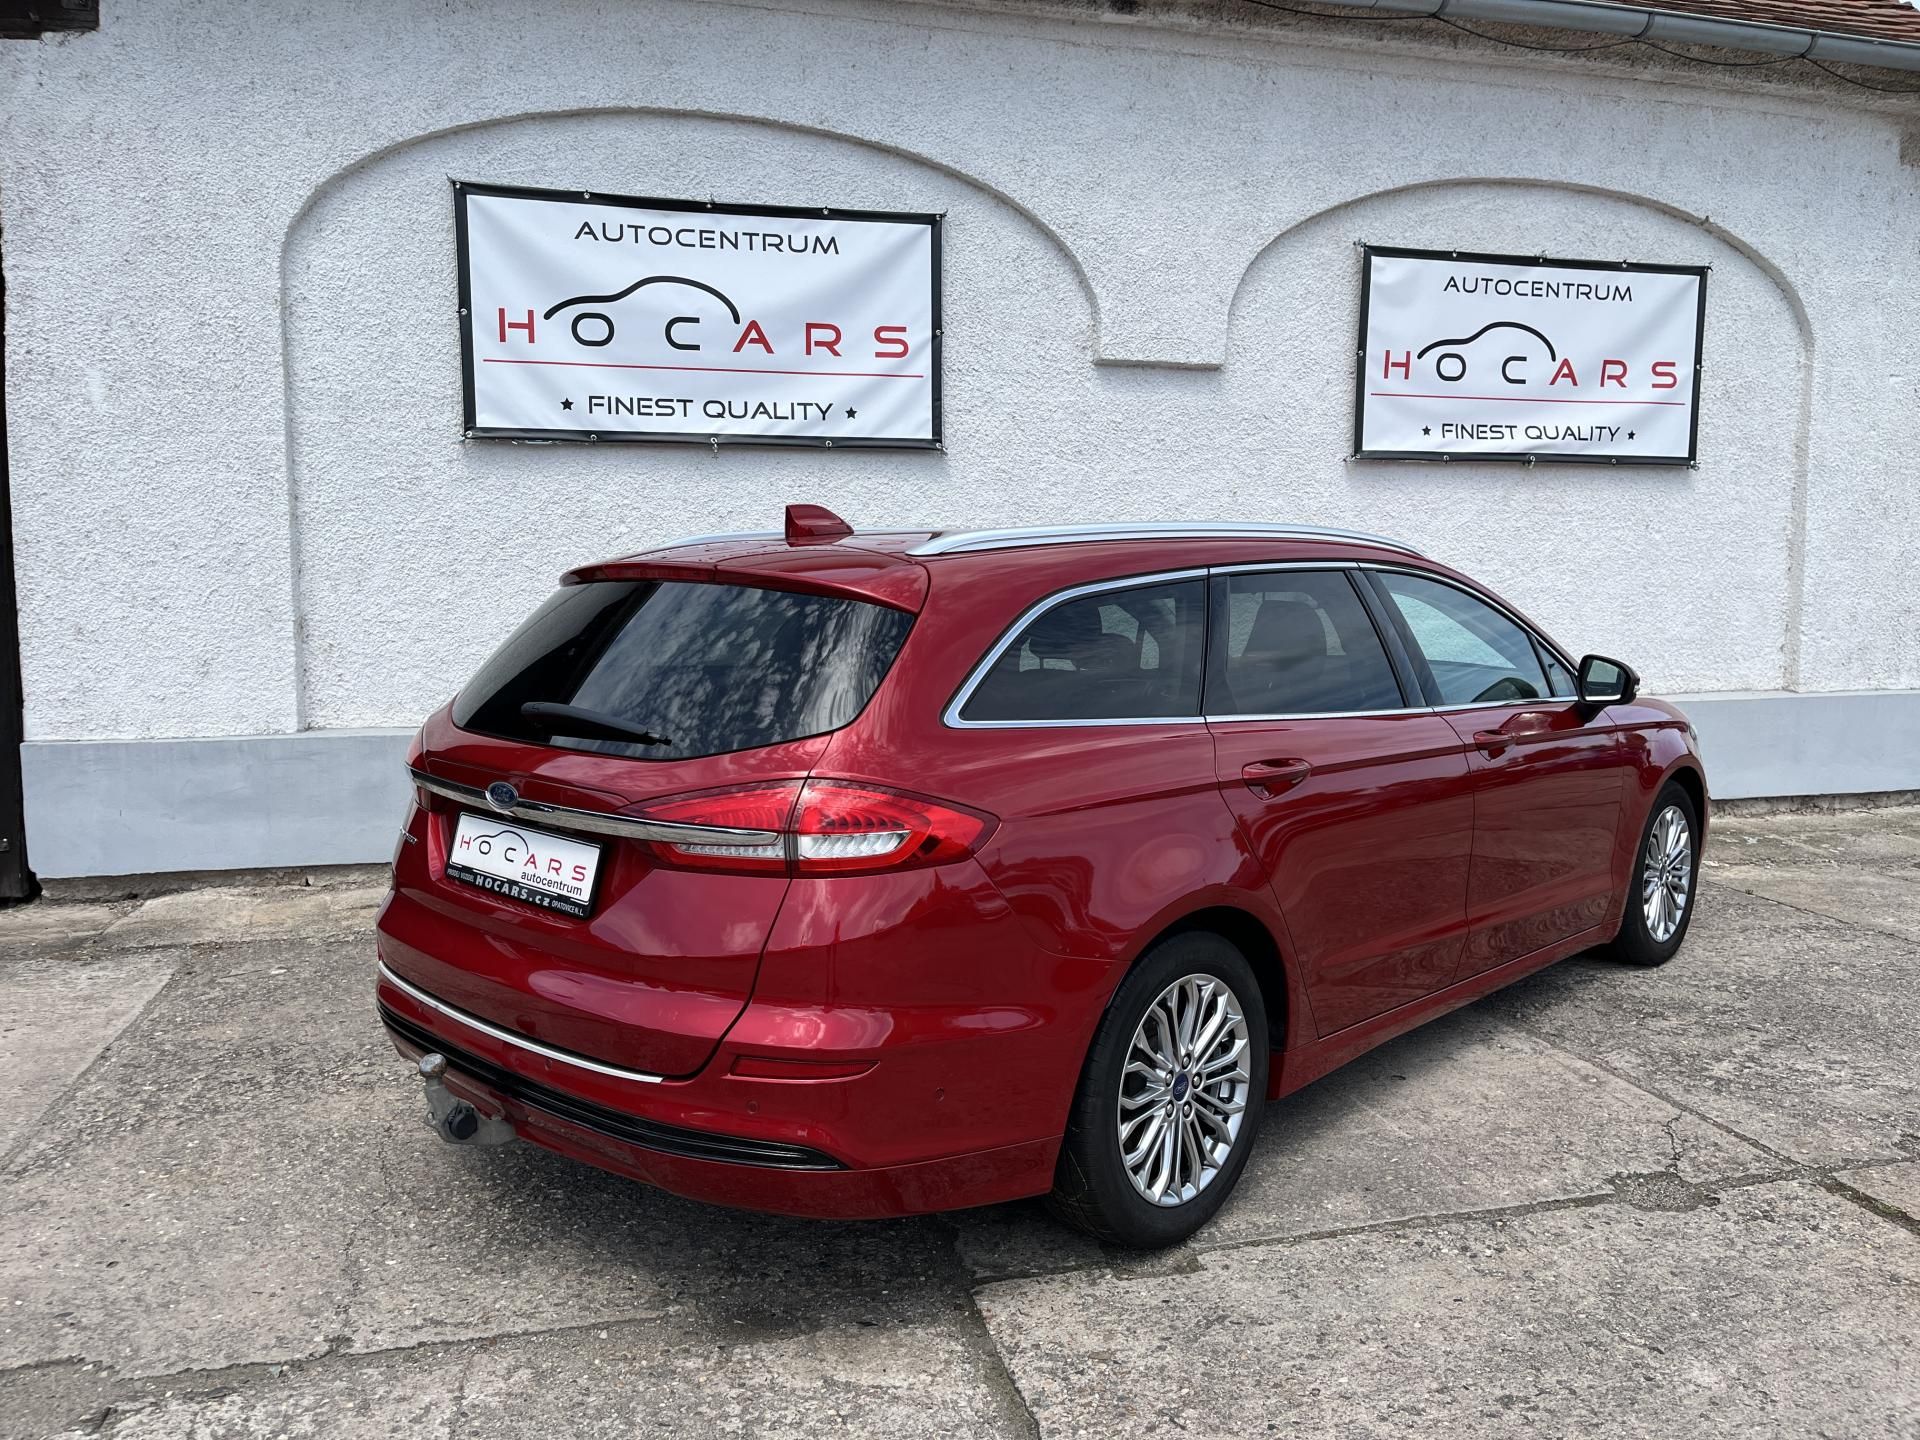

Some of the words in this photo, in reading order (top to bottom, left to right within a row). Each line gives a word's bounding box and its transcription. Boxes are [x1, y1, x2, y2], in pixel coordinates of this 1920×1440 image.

[574, 221, 840, 255] AUTOCENTRUM
[1443, 275, 1633, 302] AUTOCENTRUM
[588, 395, 694, 418] FINEST
[702, 399, 834, 421] QUALITY
[1441, 422, 1518, 441] FINEST
[1524, 425, 1621, 442] QUALITY
[521, 871, 583, 896] autocentrum
